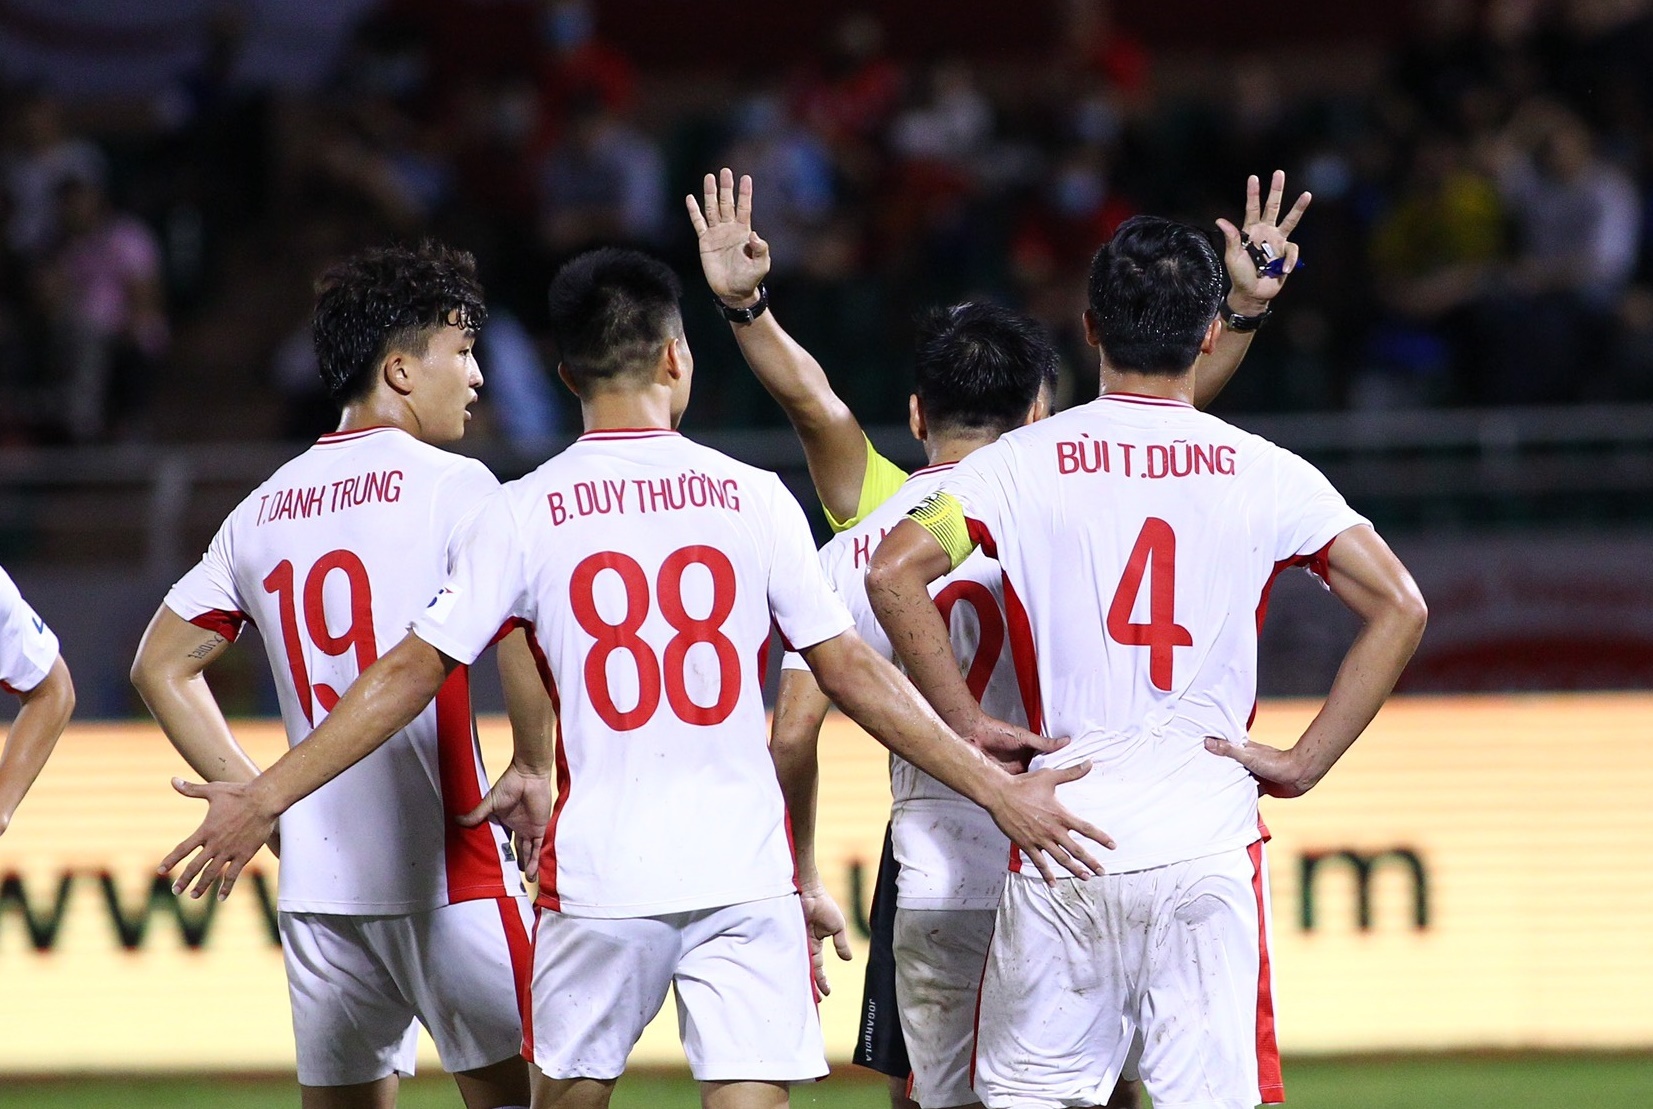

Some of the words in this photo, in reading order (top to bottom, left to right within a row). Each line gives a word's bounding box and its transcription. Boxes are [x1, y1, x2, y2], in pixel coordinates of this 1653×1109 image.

[1056, 432, 1110, 475] BÙI
[331, 470, 403, 513] TRUNG
[631, 469, 740, 514] THƯỜNG
[1106, 516, 1193, 691] 4
[262, 549, 378, 730] 19
[569, 544, 742, 732] 88
[864, 998, 877, 1062] JOGARBOLA
